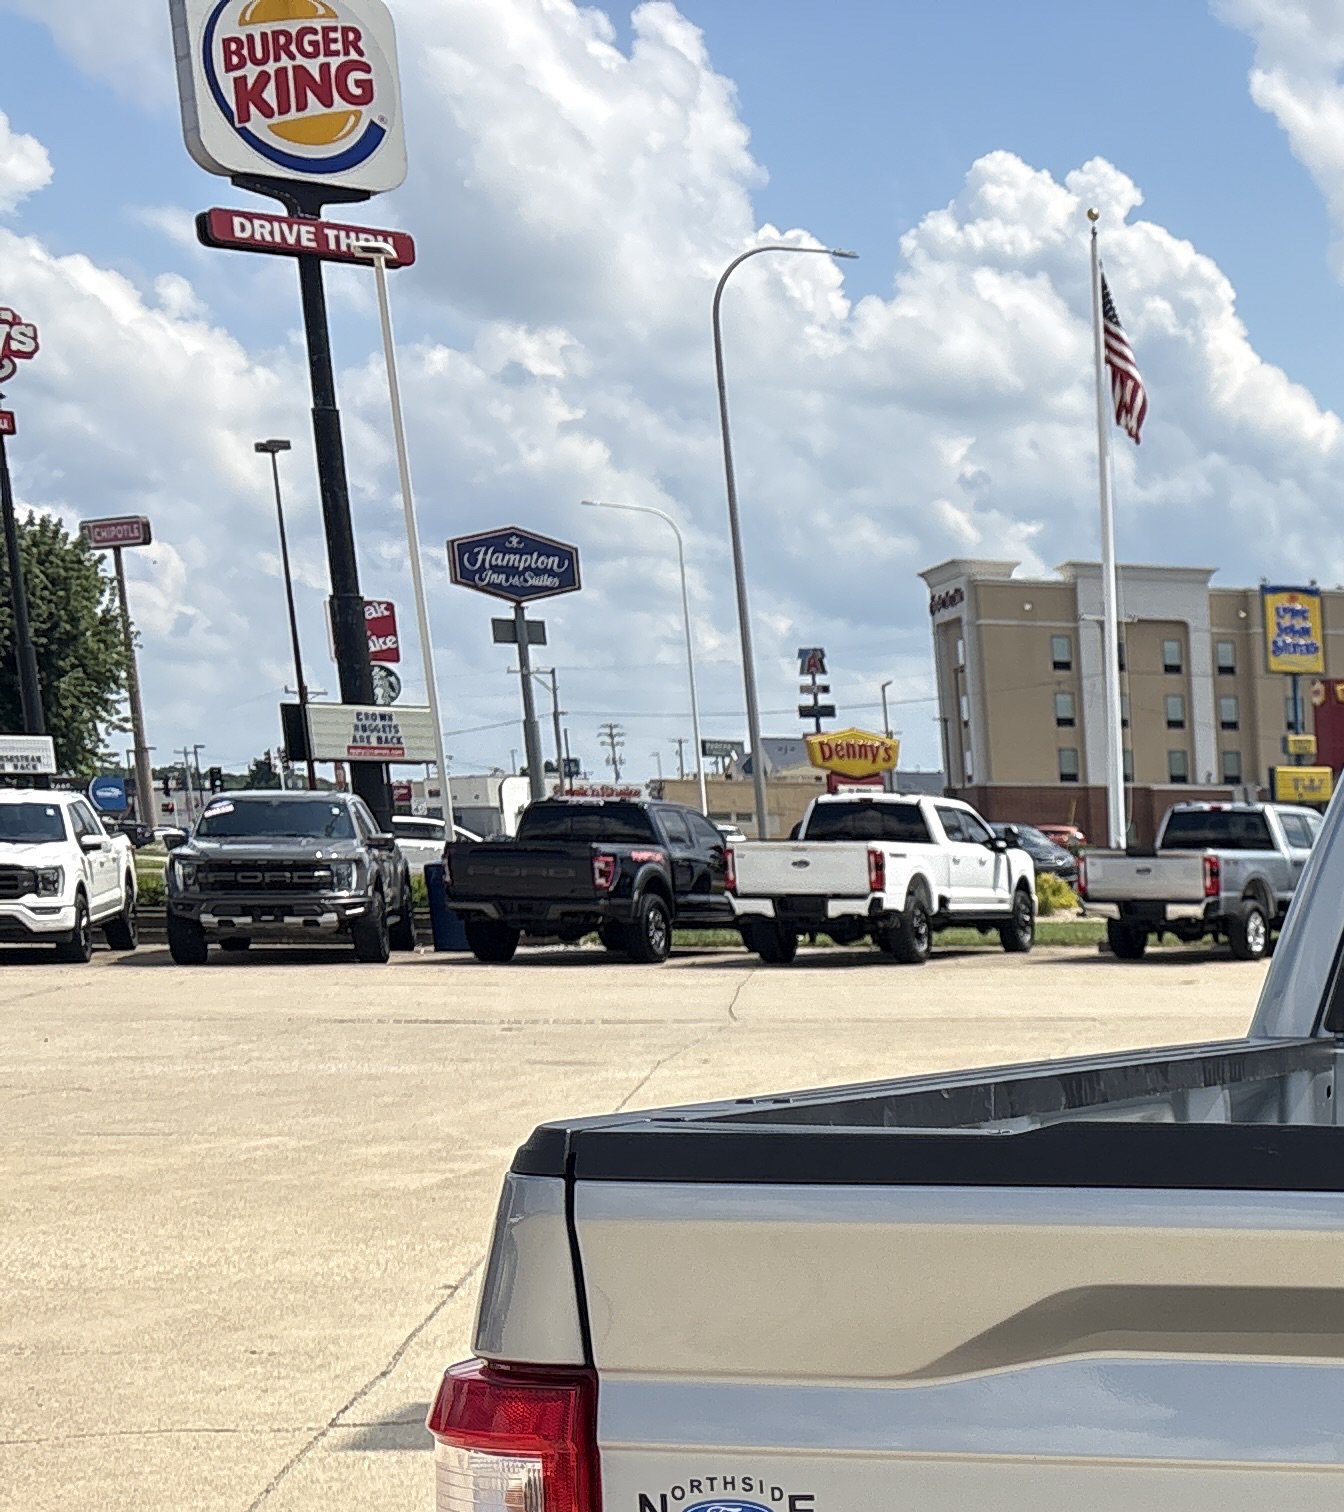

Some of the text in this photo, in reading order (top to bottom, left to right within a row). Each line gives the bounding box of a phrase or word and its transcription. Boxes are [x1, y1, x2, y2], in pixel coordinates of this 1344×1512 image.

[222, 26, 364, 73] BURGER
[233, 59, 374, 124] KING
[232, 216, 317, 248] DRIVE
[94, 524, 139, 540] CHIPOTLE
[463, 546, 568, 573] Hampton
[475, 570, 512, 587] Inn
[376, 735, 403, 746] BACK
[818, 740, 894, 765] Denny's
